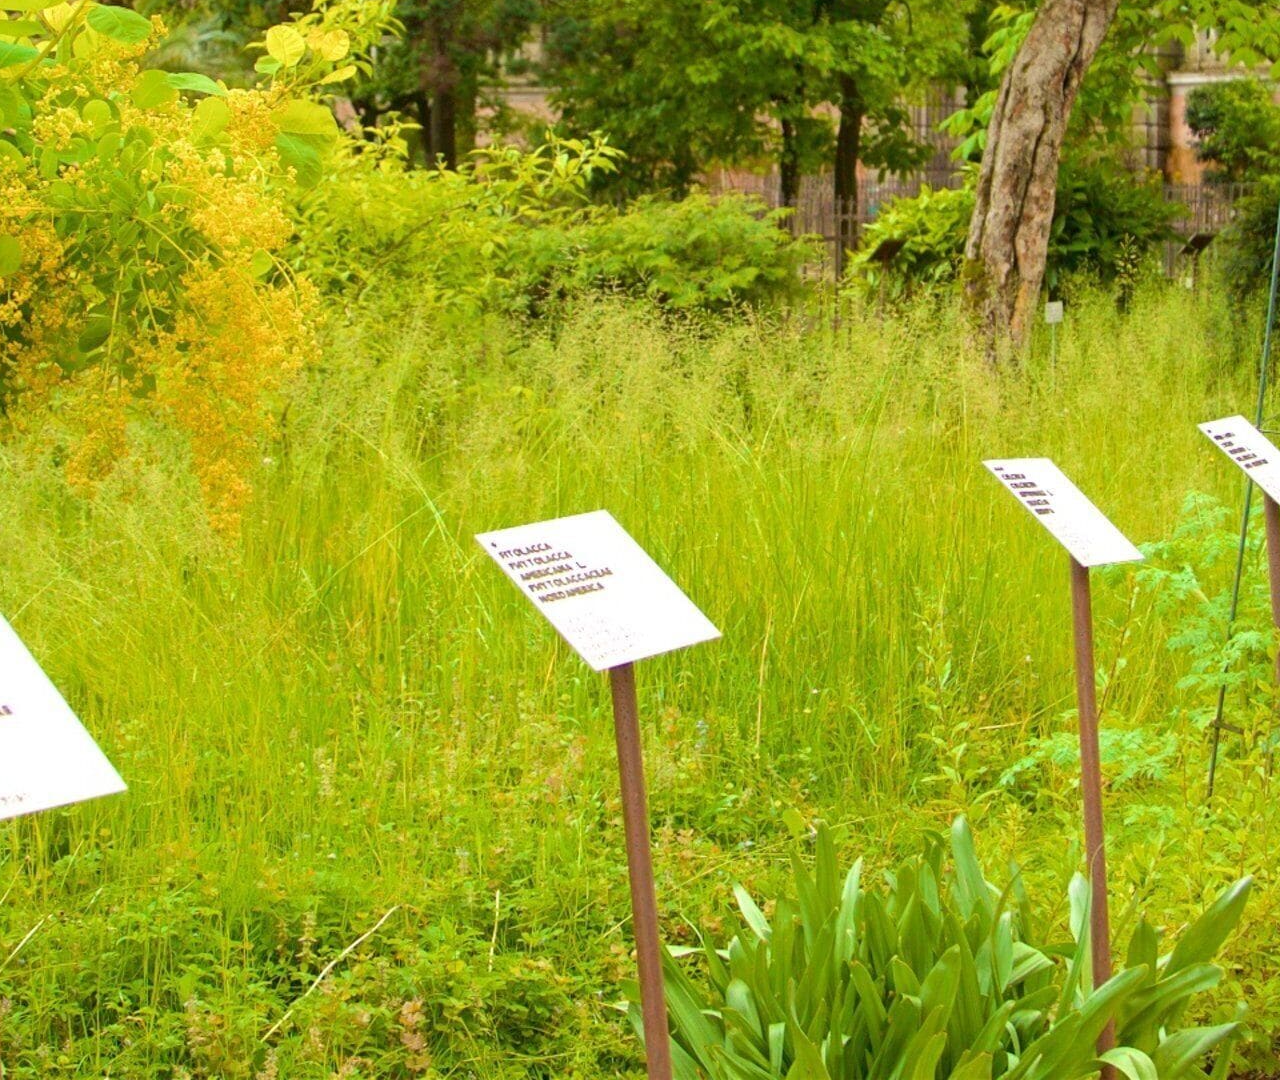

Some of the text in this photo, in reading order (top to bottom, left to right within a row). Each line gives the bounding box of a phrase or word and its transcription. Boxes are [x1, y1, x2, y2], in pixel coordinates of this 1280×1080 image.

[498, 543, 552, 559] FITOLACCA
[508, 551, 573, 570] PHYTOLACCA
[520, 563, 573, 581] AMERICANA
[528, 567, 613, 592] PHYTOLACCACEAE
